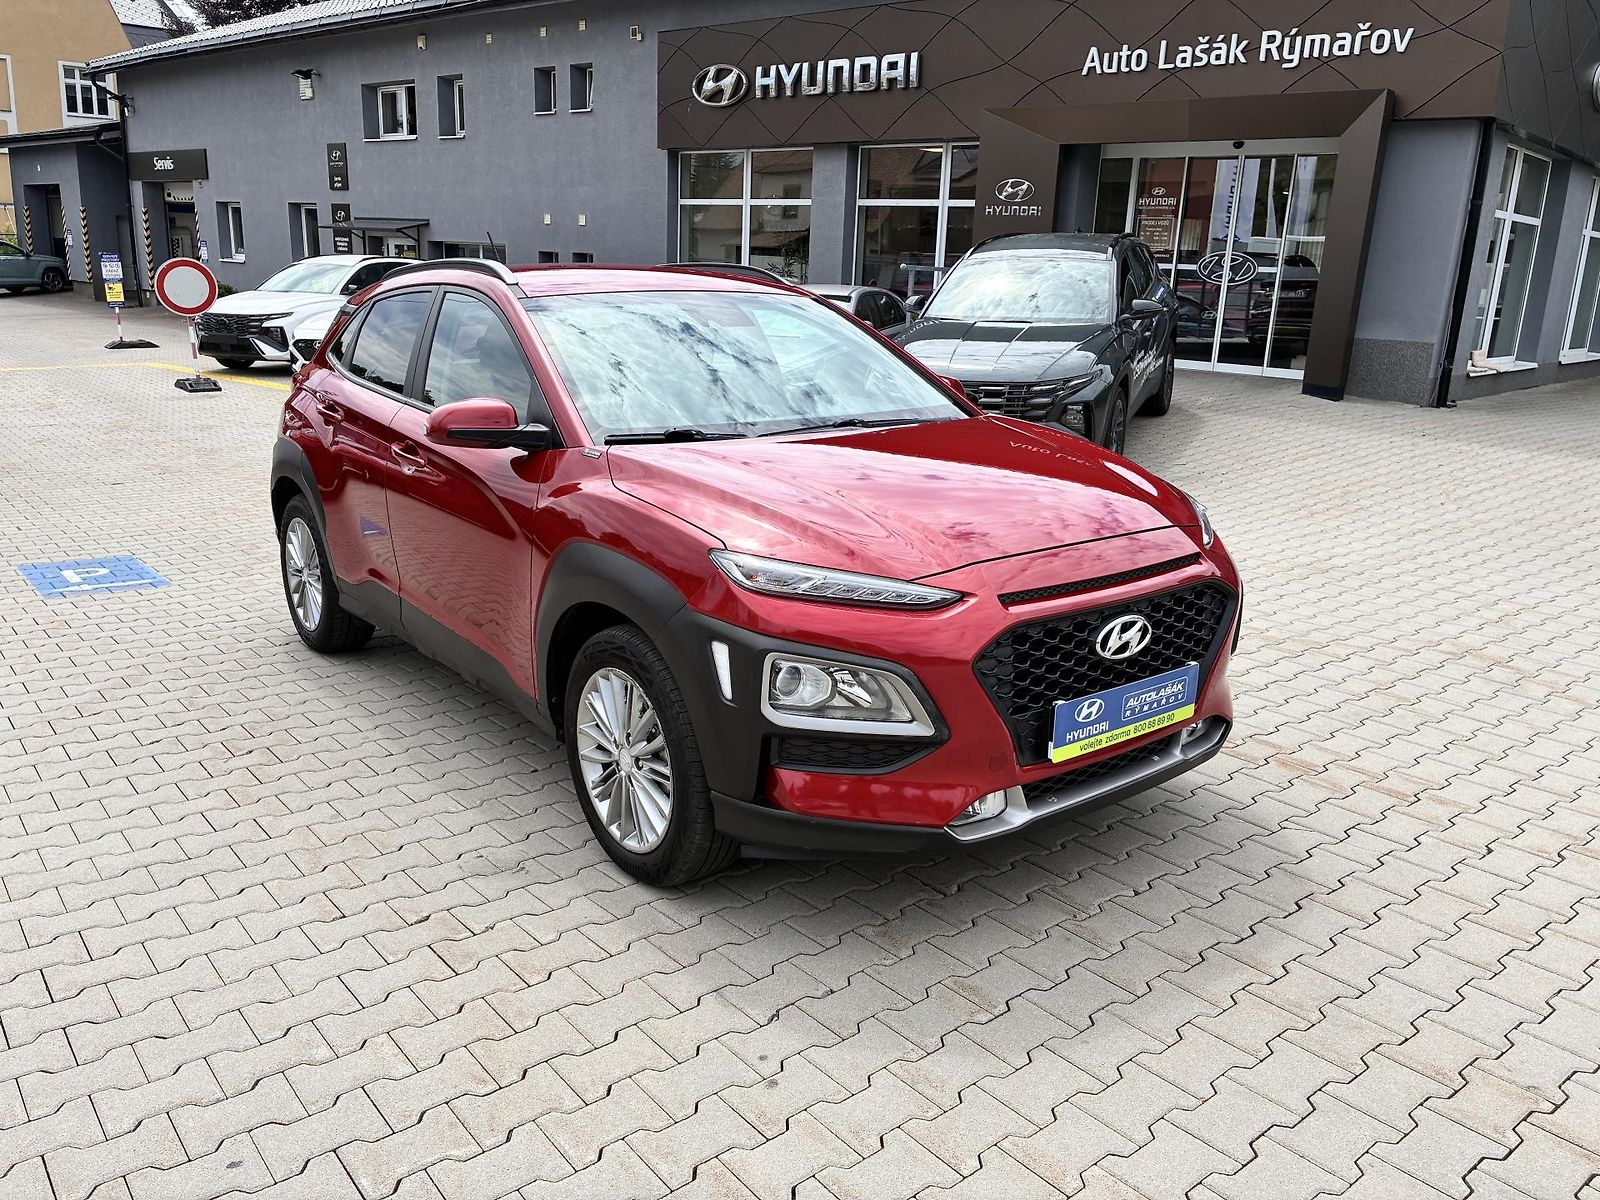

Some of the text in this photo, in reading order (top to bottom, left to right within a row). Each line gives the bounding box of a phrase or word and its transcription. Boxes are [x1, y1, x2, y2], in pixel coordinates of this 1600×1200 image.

[1081, 22, 1415, 75] Auto Lašák Rýmařov
[755, 51, 921, 99] HYUNDAI
[153, 156, 174, 170] Servis
[985, 205, 1042, 216] HYUNDAI
[1138, 197, 1177, 206] HYUNDAI
[61, 567, 110, 583] P
[1126, 681, 1185, 708] AUTOLAŠÁK
[1066, 720, 1109, 743] HYUNDAI
[1079, 712, 1175, 752] volejte zdarma 800 88 89 90
